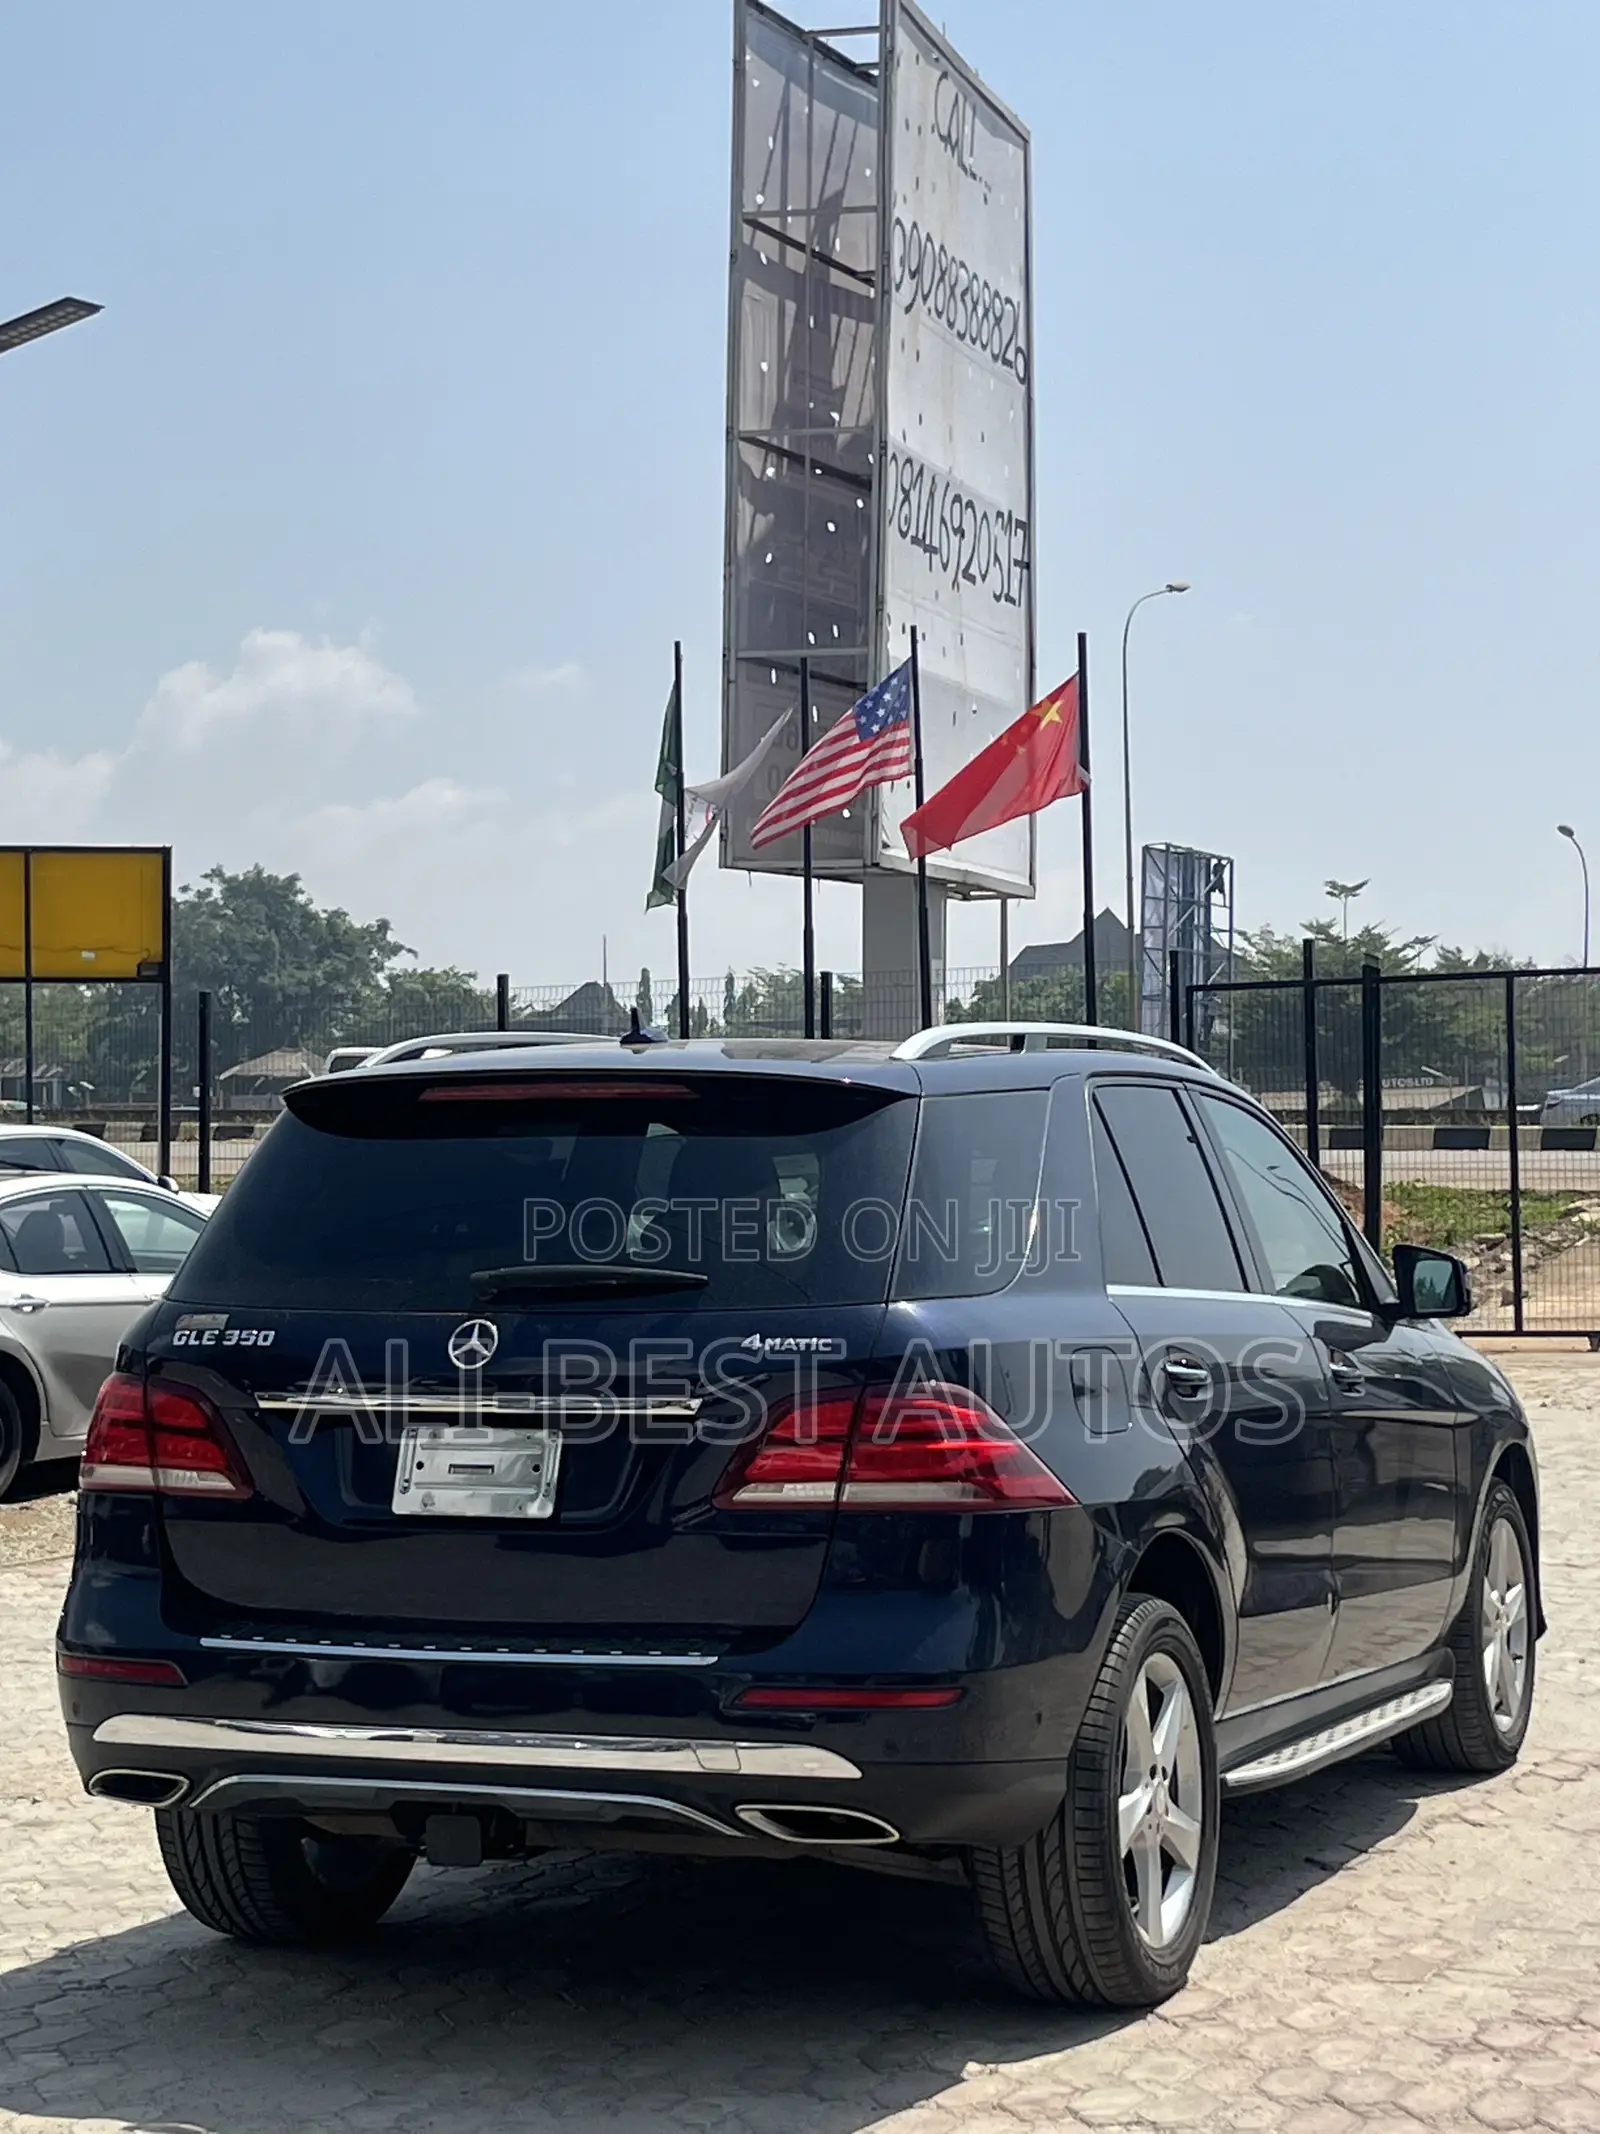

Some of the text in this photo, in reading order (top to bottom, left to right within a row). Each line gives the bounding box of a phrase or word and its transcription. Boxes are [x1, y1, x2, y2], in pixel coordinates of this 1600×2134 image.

[1381, 1077, 1414, 1088] UTOS
[172, 1330, 275, 1346] GLE 350
[741, 1333, 832, 1351] 4MATIC
